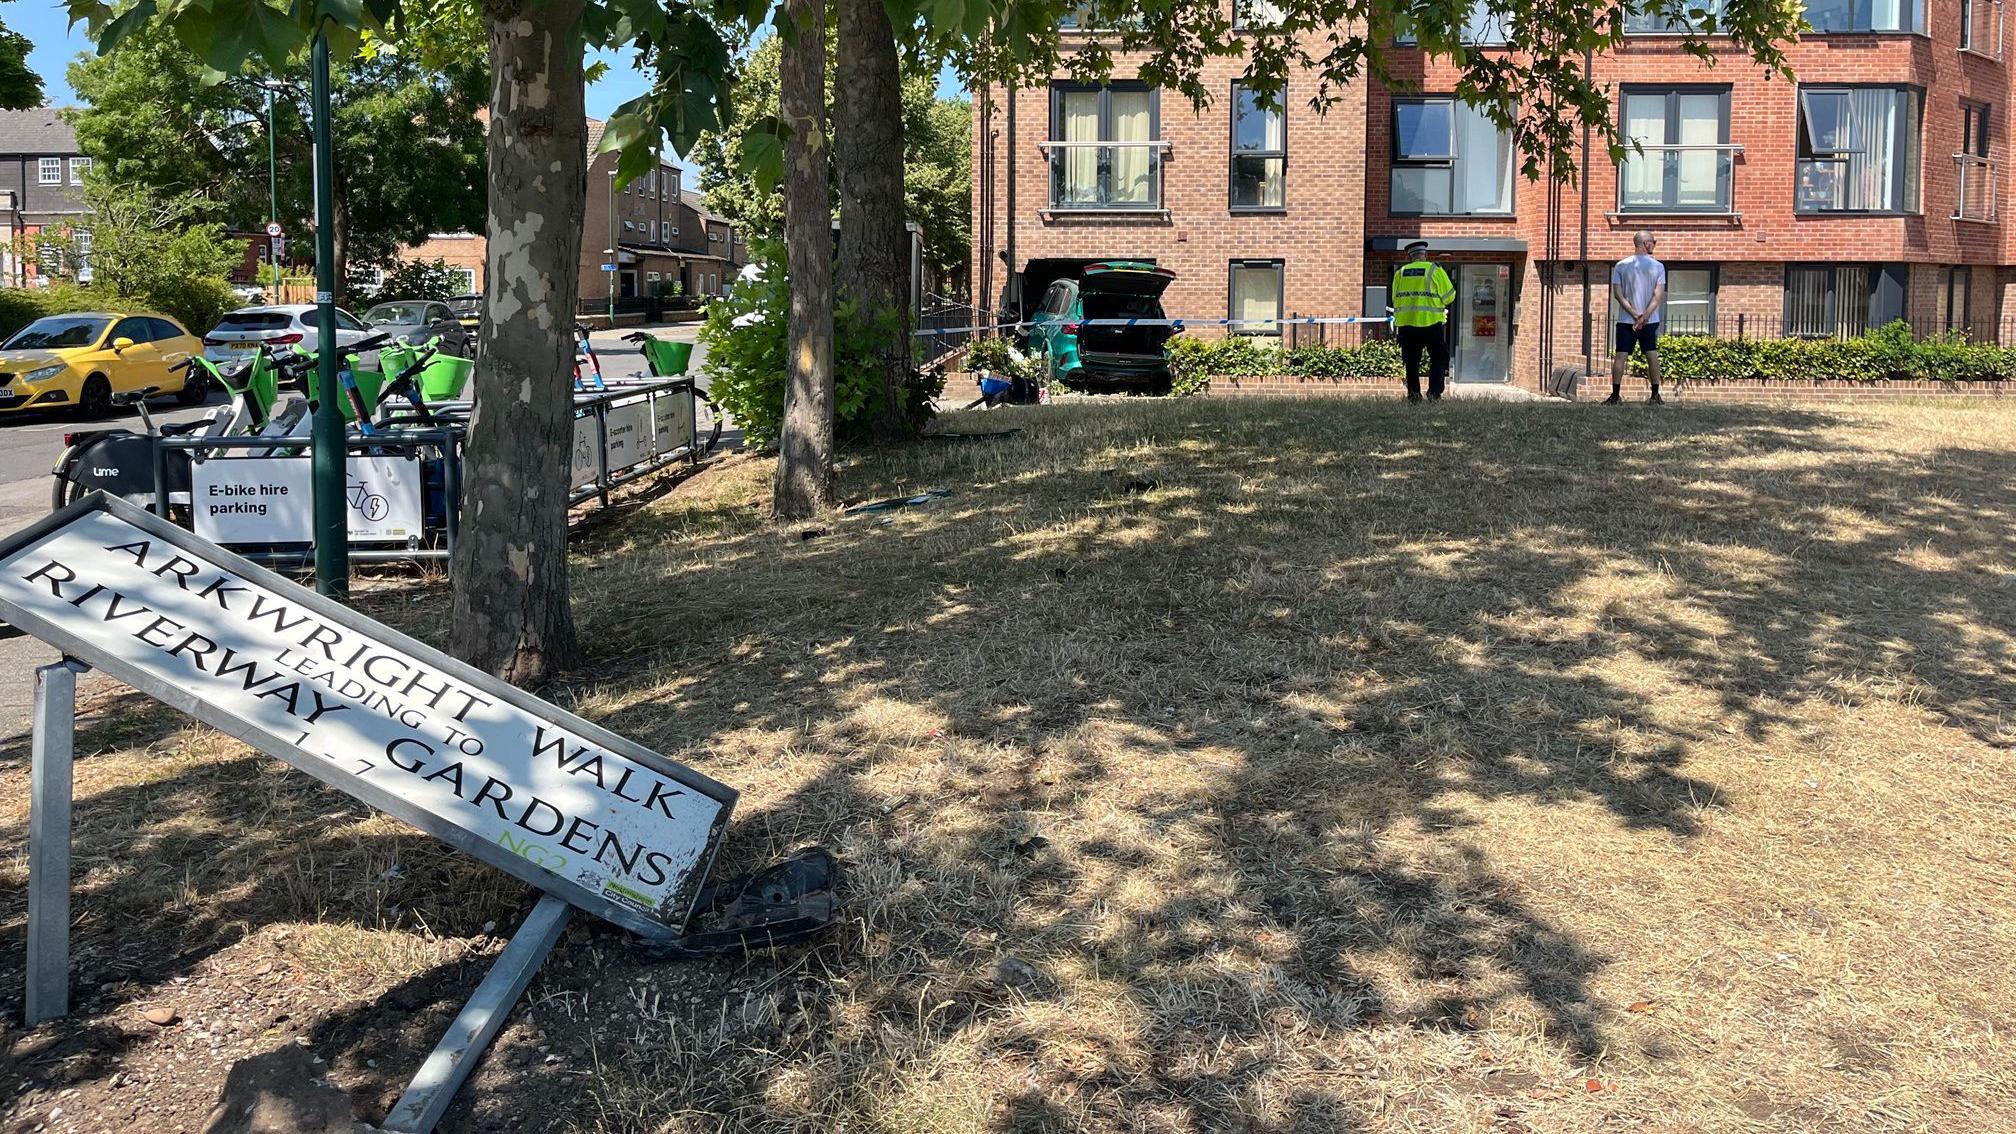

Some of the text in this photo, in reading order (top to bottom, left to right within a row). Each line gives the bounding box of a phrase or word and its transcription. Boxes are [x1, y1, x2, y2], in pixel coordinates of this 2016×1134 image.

[209, 484, 289, 496] E-bike hire
[210, 502, 267, 516] parking
[103, 540, 687, 820] ARKWRIGHT WALK
[274, 648, 484, 757] LEADING TO
[22, 560, 673, 886] RIVERWAY GARDENS
[355, 758, 376, 776] 7
[497, 829, 568, 873] NG2
[604, 889, 621, 901] City
